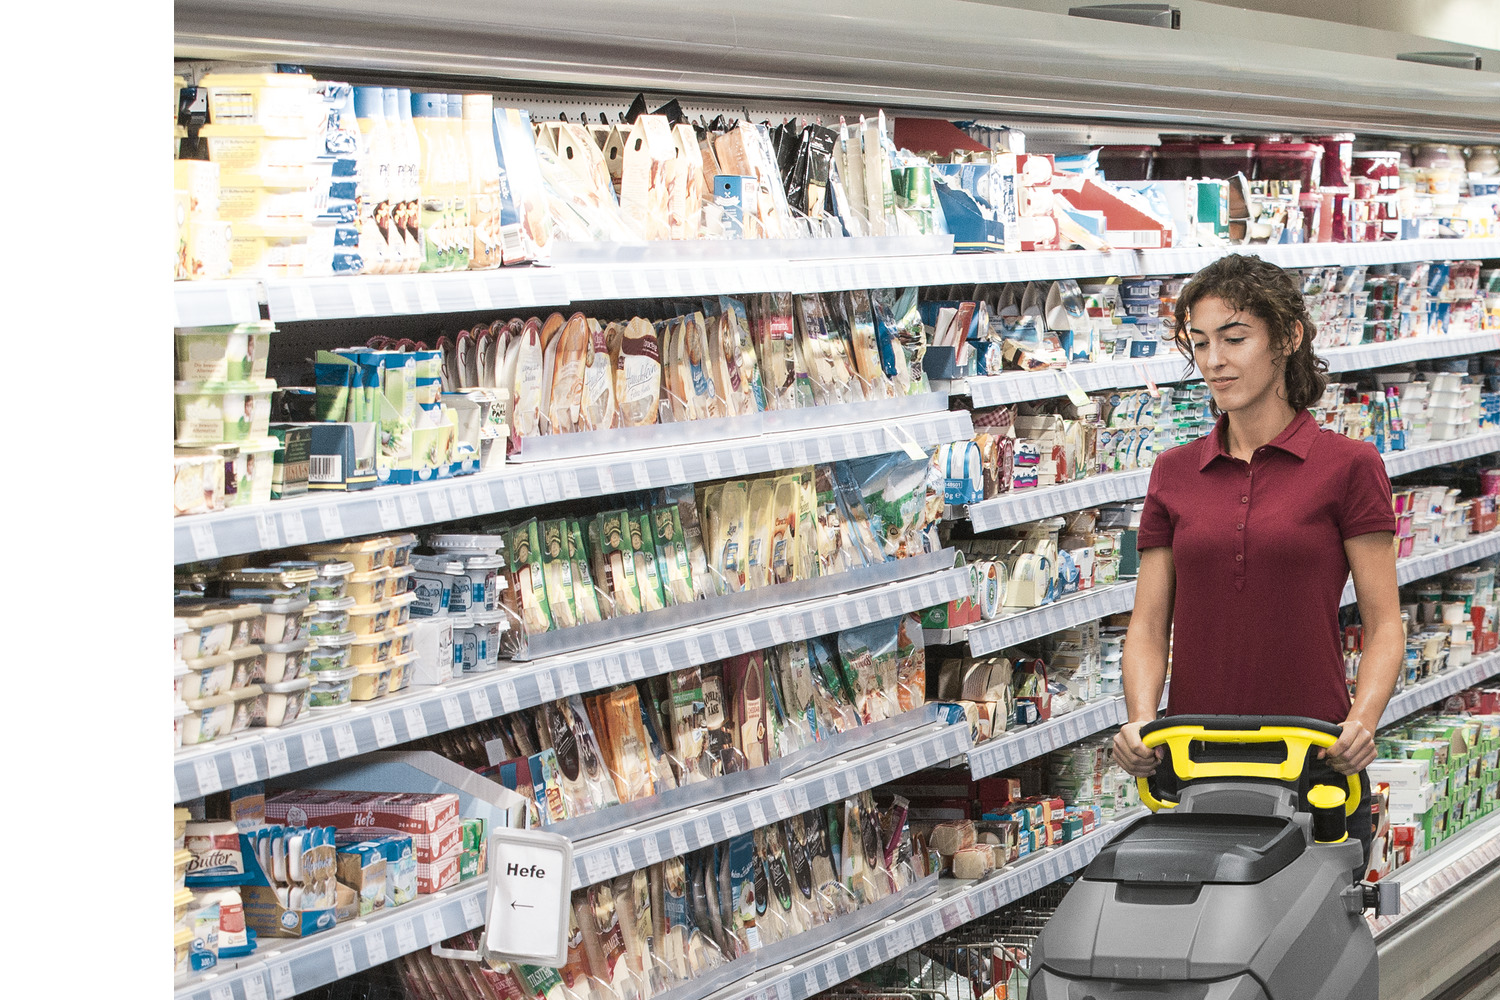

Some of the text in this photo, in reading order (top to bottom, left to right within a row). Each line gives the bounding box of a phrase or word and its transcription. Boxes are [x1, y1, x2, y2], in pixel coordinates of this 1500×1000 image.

[354, 809, 375, 827] Hefe
[187, 851, 233, 871] Butter
[506, 862, 546, 880] Hefe
